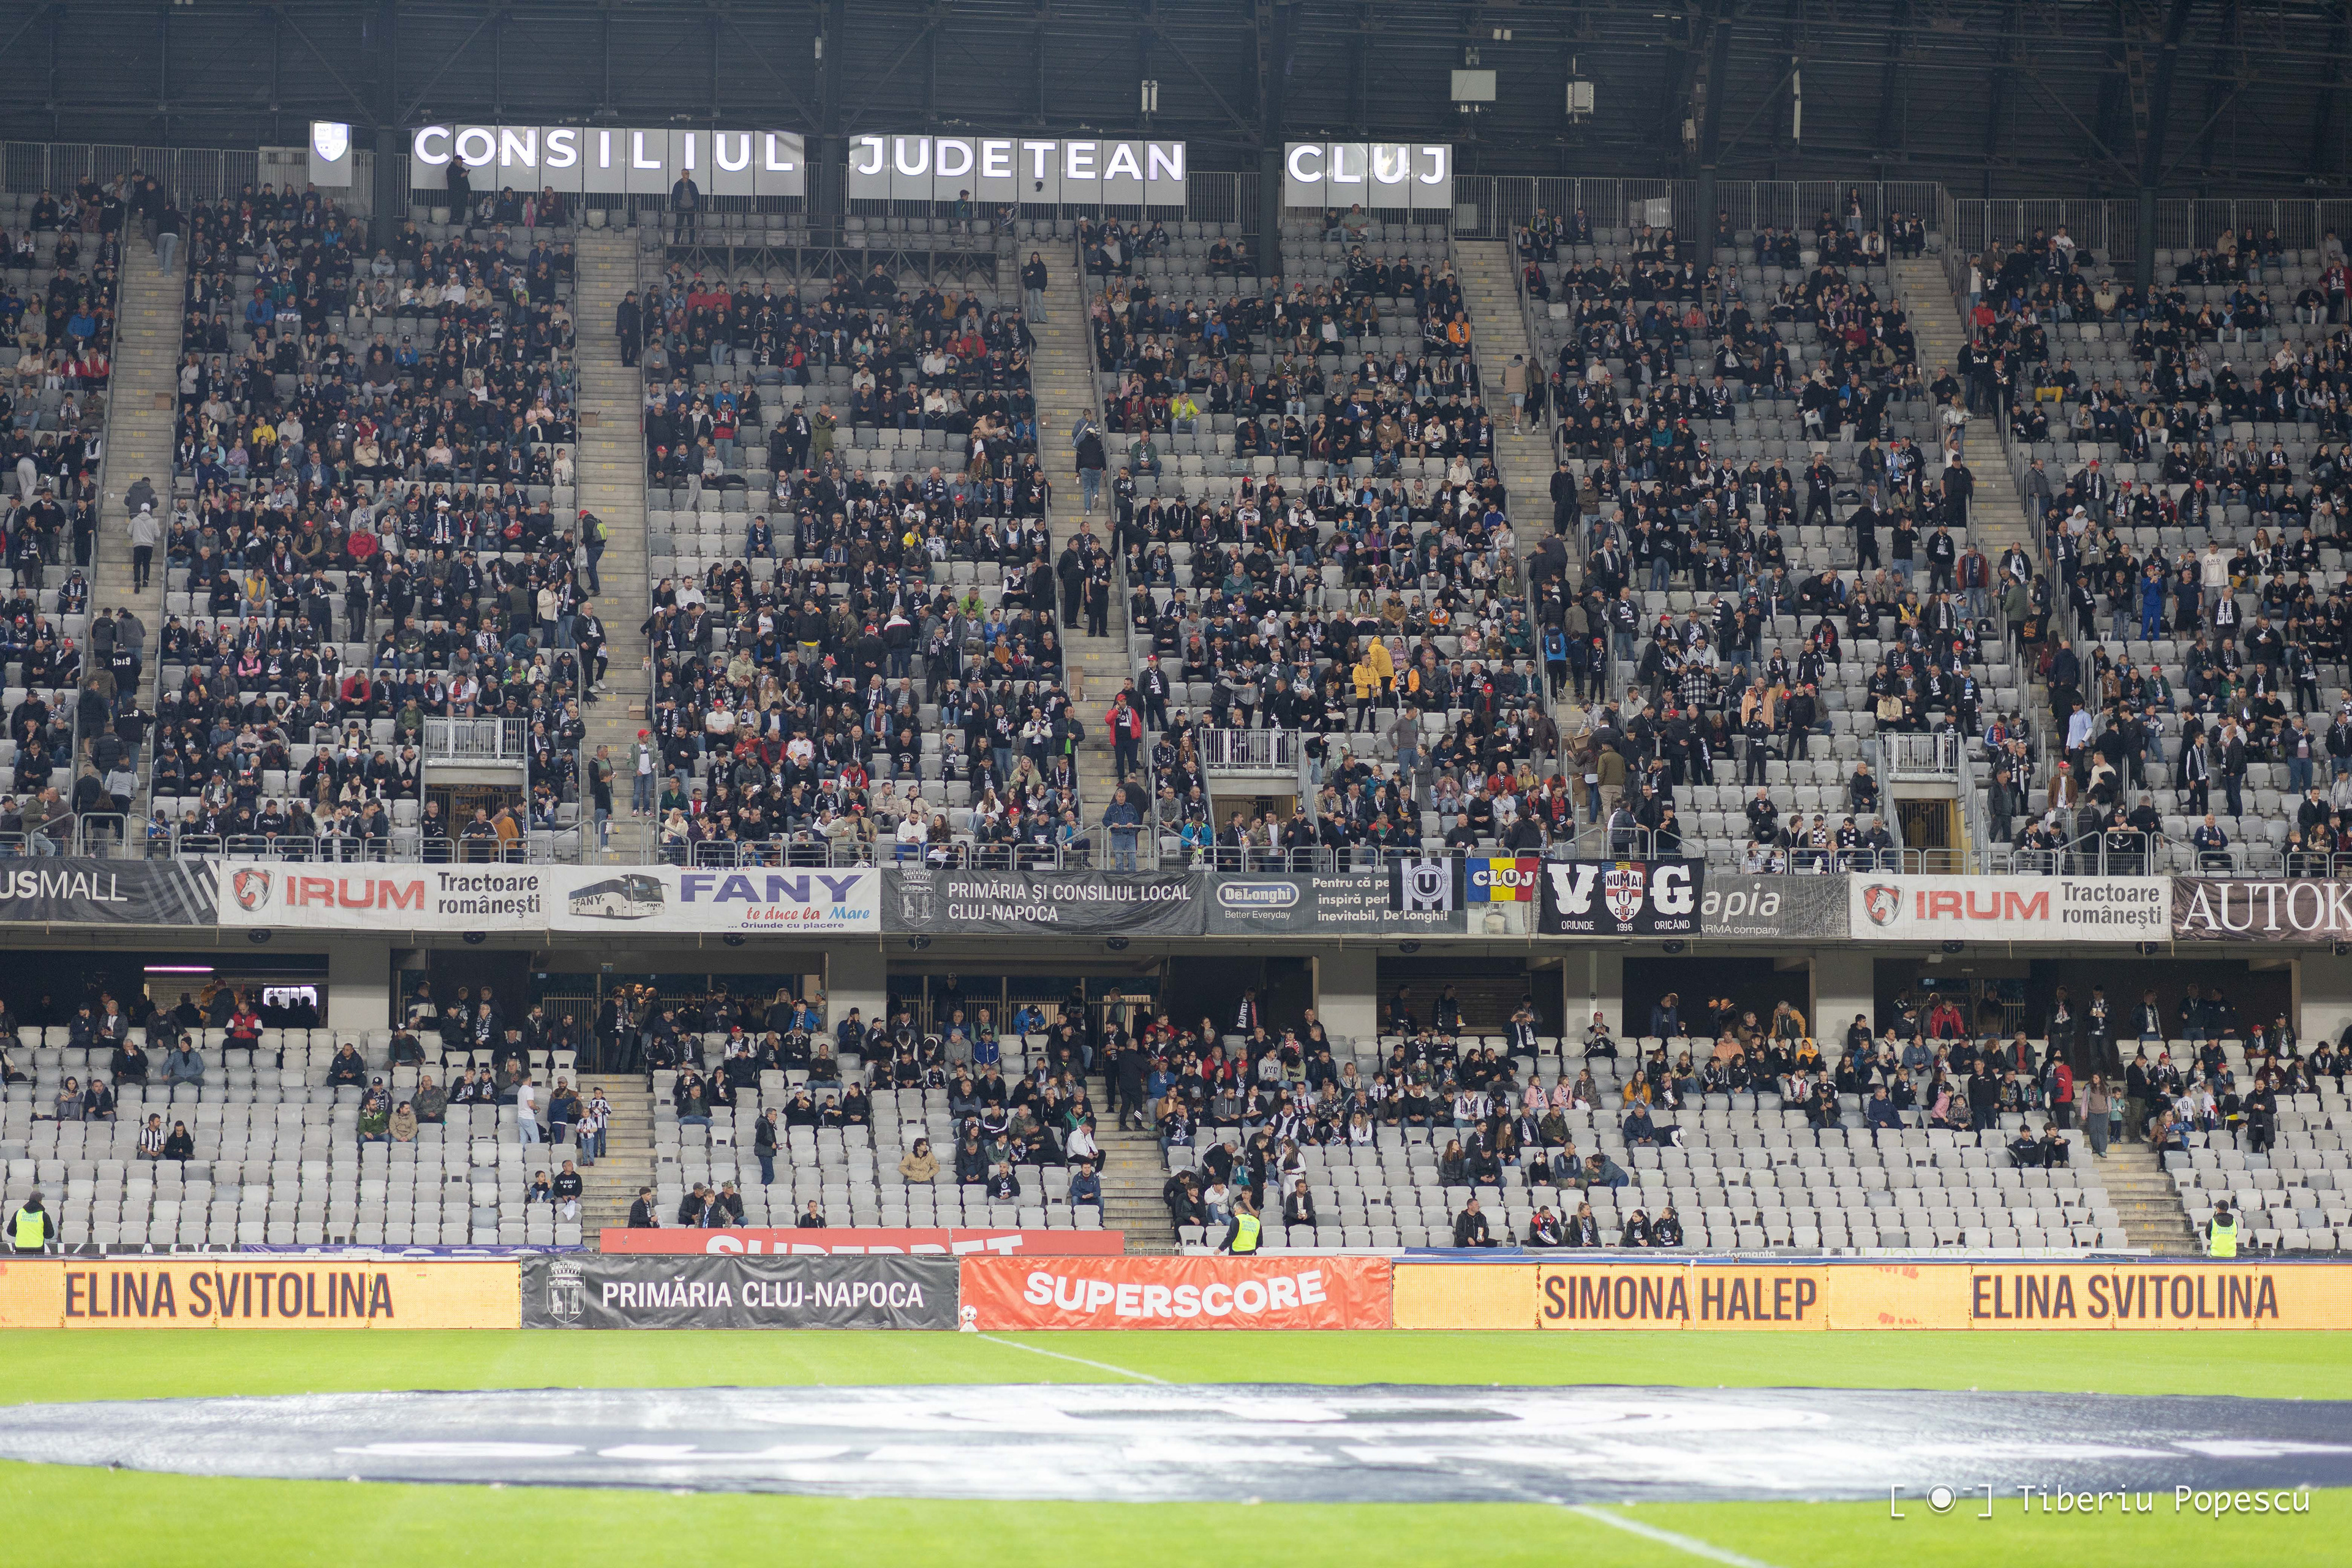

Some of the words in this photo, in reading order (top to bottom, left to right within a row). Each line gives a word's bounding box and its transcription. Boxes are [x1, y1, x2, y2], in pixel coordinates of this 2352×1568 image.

[414, 126, 794, 172] CONSILIUL
[1287, 145, 1446, 184] CLUJ
[1411, 865, 1442, 875] UNIVERSITATEA
[1472, 868, 1534, 888] CLUJ
[437, 872, 538, 892] Tractoare
[681, 875, 863, 902] FANY
[948, 880, 1026, 900] PRIMĂRIA
[1052, 884, 1136, 901] CONSILIUL
[1140, 884, 1191, 900] LOCAL
[1313, 878, 1353, 888] Pentru
[1357, 876, 1370, 888] că
[1375, 880, 1389, 890] pe
[1418, 874, 1436, 894] U
[1547, 864, 1599, 914] V
[1650, 864, 1694, 914] G
[1607, 873, 1642, 888] NUMAI
[286, 875, 425, 910] IRUM
[1319, 893, 1361, 907] inspiră
[1618, 891, 1629, 904] U
[2061, 882, 2160, 902] Tractoare
[747, 907, 760, 919] te
[764, 907, 798, 919] duce
[803, 907, 820, 919] la
[828, 907, 870, 919] Mare
[948, 903, 1058, 921] CLUJ-NAPOCA
[1701, 883, 1781, 923] apia
[1916, 891, 2049, 921] IRUM
[1252, 911, 1291, 920] Everyday
[1317, 910, 1379, 922] inevitabil,
[1561, 921, 1594, 930] ORIUNDE
[1654, 919, 1690, 930] ORICÂND
[1616, 923, 1633, 932] 1996
[1701, 925, 1732, 933] ARMA
[1734, 925, 1780, 936] company
[2182, 1101, 2188, 1110] 10
[65, 1272, 176, 1317] ELINA
[188, 1272, 394, 1317] SVITOLINA
[602, 1276, 733, 1308] PRIMĂRIA
[742, 1281, 924, 1308] CLUJ-NAPOCA
[1023, 1270, 1327, 1318] SUPERSCORE
[1544, 1275, 1690, 1320] SIMONA
[1701, 1277, 1817, 1321] HALEP
[1972, 1274, 2076, 1319] ELINA
[2087, 1274, 2279, 1319] SVITOLINA
